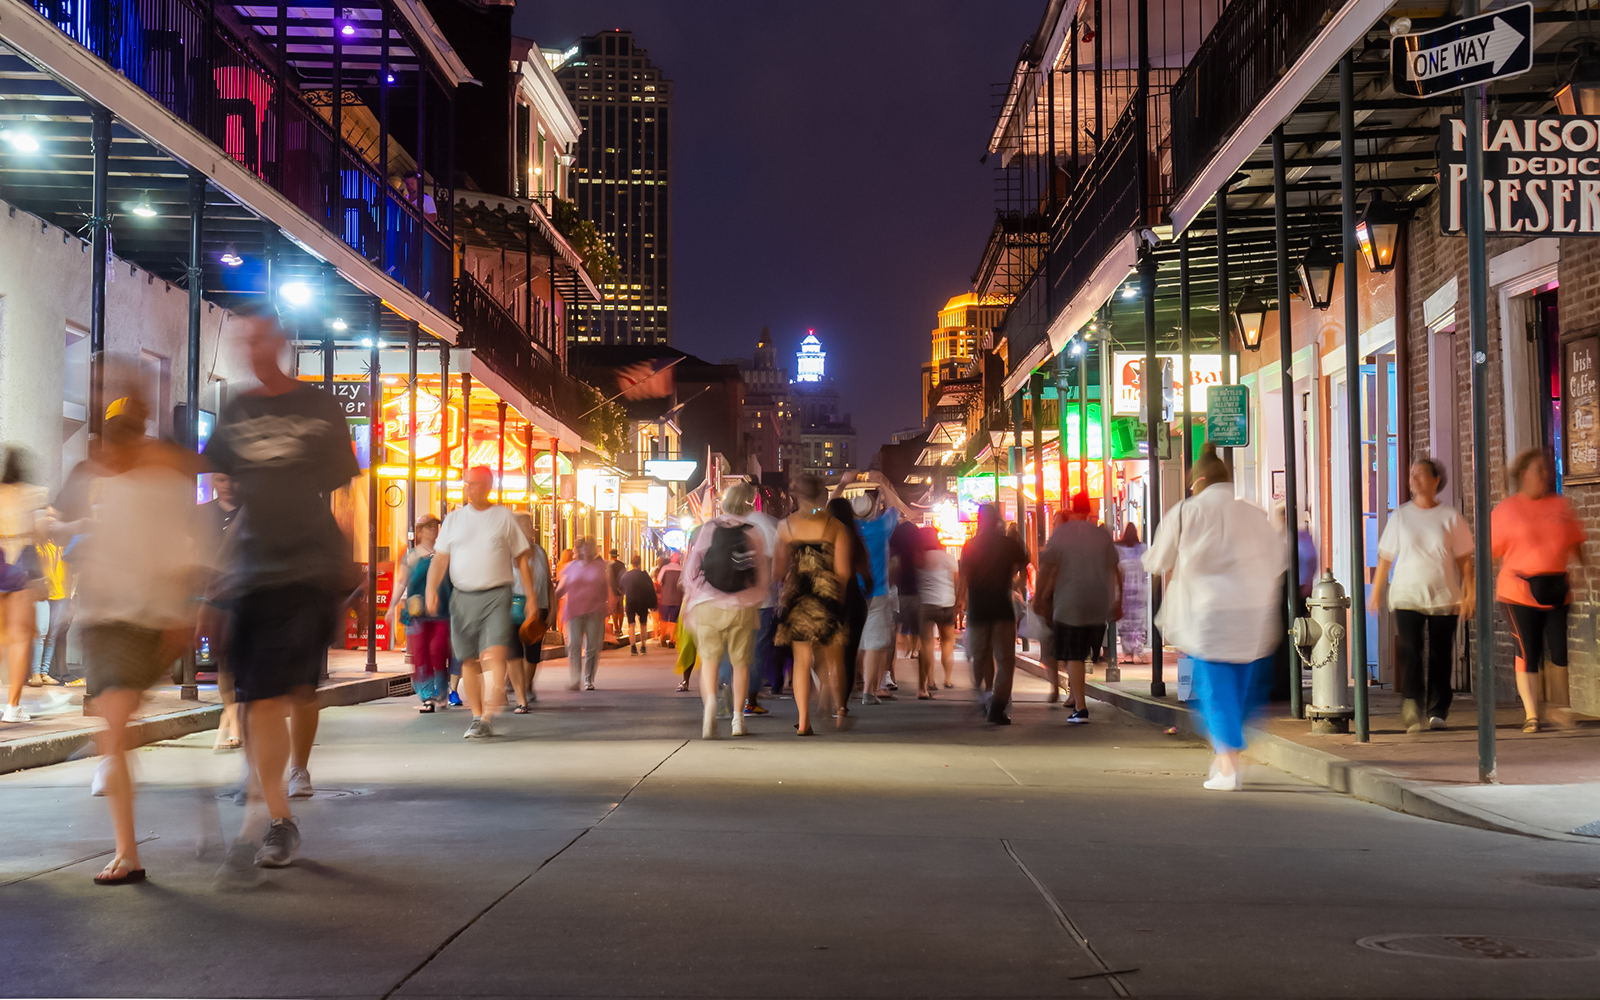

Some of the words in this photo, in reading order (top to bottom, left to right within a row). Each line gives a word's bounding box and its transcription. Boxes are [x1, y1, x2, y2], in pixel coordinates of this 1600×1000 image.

[1413, 47, 1449, 77] ONE
[1454, 35, 1490, 67] WAY
[1449, 118, 1600, 152] MAISO
[1570, 374, 1596, 397] Coffee
